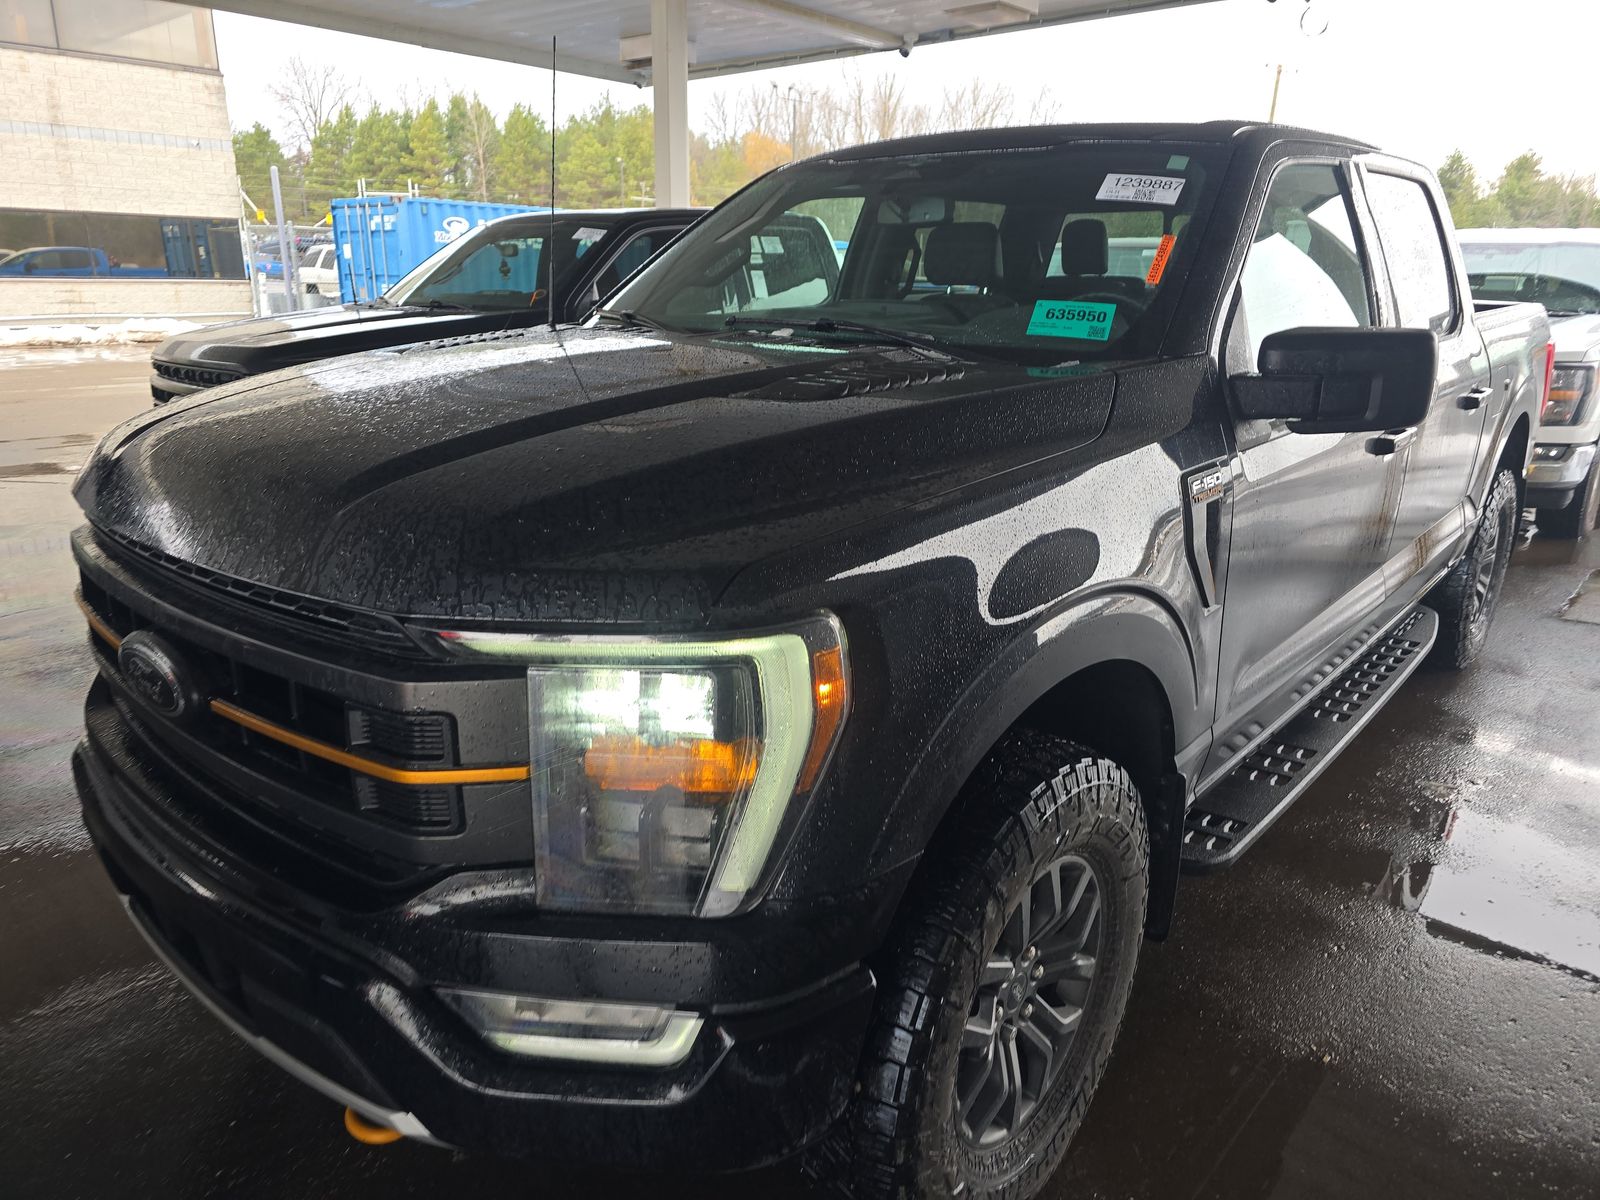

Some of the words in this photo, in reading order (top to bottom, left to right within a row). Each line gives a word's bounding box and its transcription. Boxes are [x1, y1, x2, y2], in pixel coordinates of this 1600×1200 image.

[1114, 176, 1184, 191] 1239887
[1045, 307, 1107, 323] 635950
[1192, 471, 1222, 494] F-150
